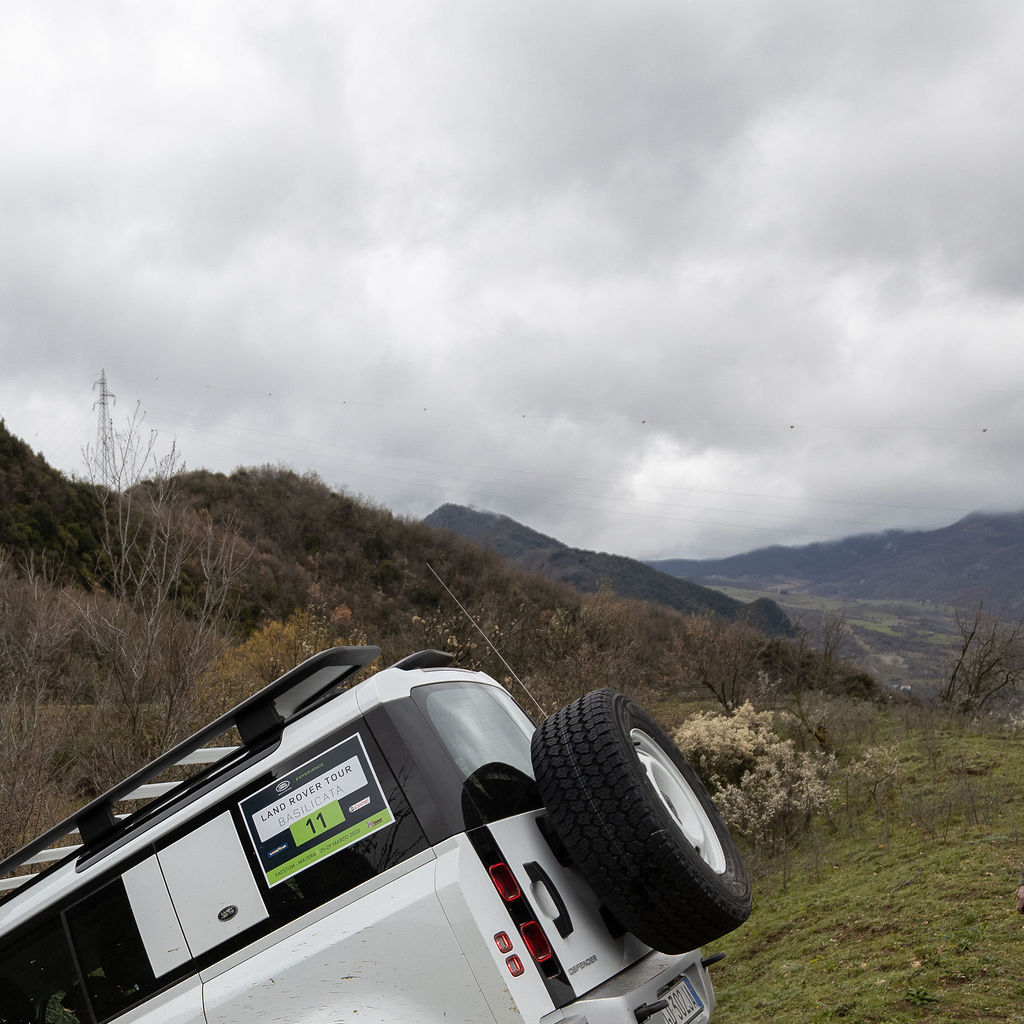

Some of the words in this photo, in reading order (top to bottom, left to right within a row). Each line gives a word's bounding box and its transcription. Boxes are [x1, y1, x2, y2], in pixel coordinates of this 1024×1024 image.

[260, 803, 286, 822] LAND
[289, 782, 323, 806] ROVER
[324, 765, 353, 785] TOUR
[277, 785, 344, 827] BASILICATA
[305, 812, 327, 834] 11
[275, 863, 296, 877] PAESTUM
[298, 851, 317, 865] MATERA
[331, 835, 349, 846] MARZO
[568, 954, 598, 975] DEFENDER
